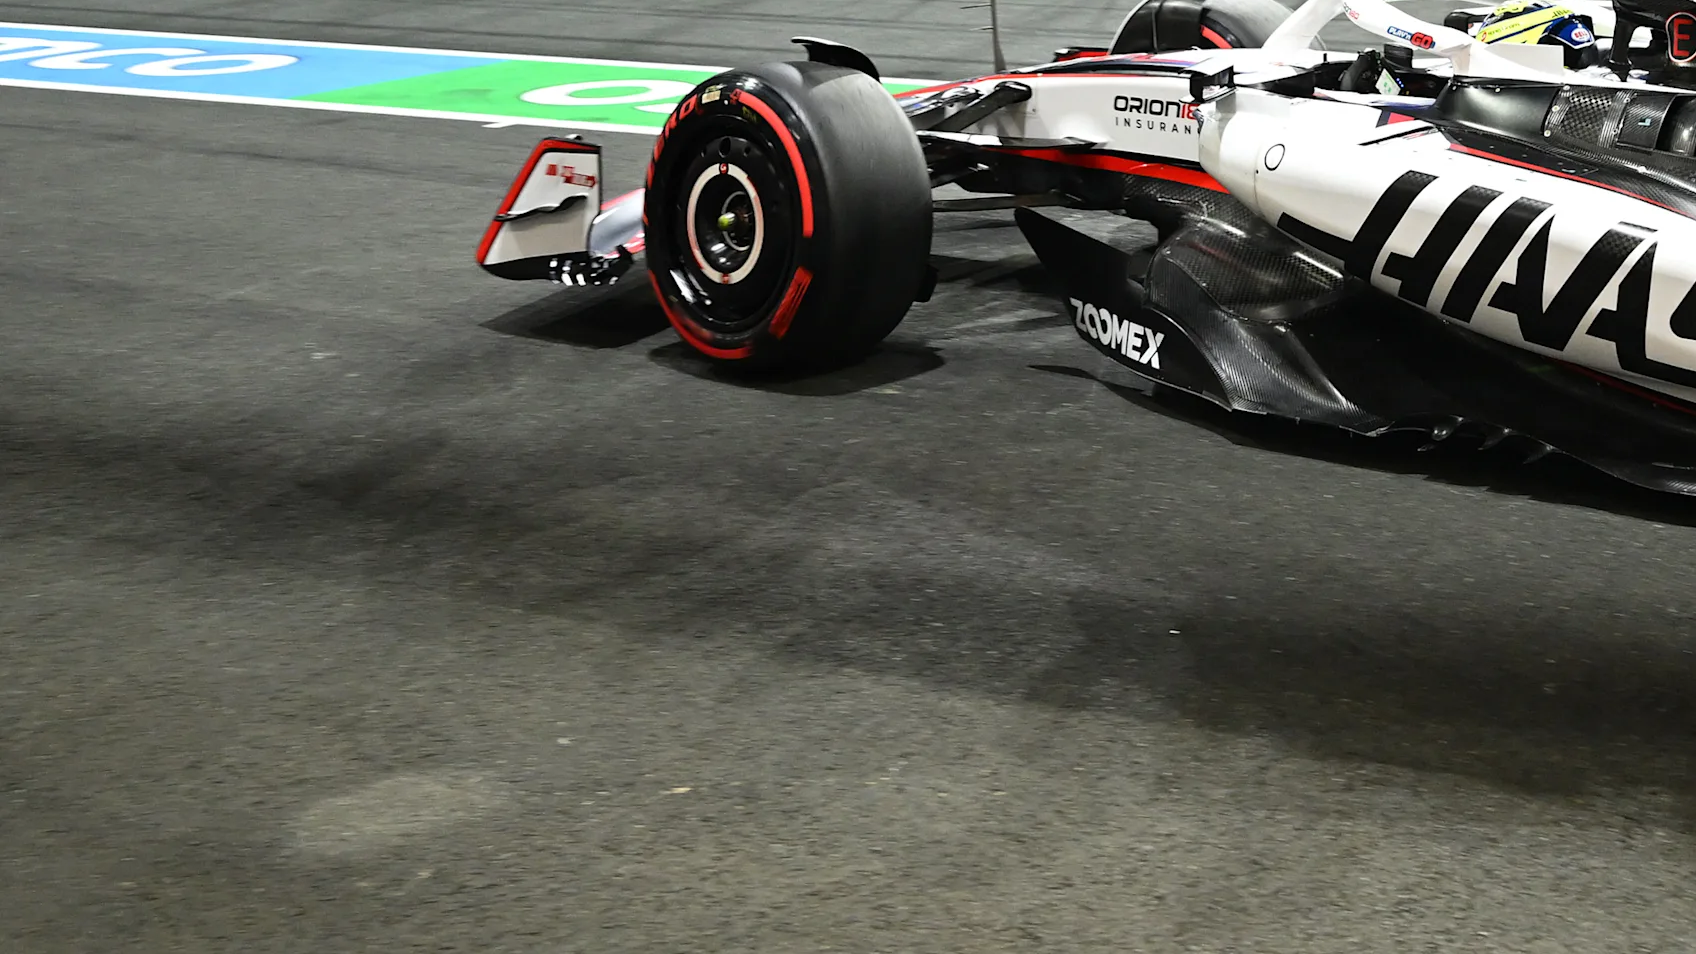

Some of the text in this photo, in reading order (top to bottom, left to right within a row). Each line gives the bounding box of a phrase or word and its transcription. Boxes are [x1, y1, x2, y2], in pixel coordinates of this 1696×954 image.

[1411, 32, 1433, 49] GO
[1114, 95, 1200, 120] ORION18
[1115, 117, 1202, 135] INSURAN
[1069, 297, 1165, 370] ZOOMEX
